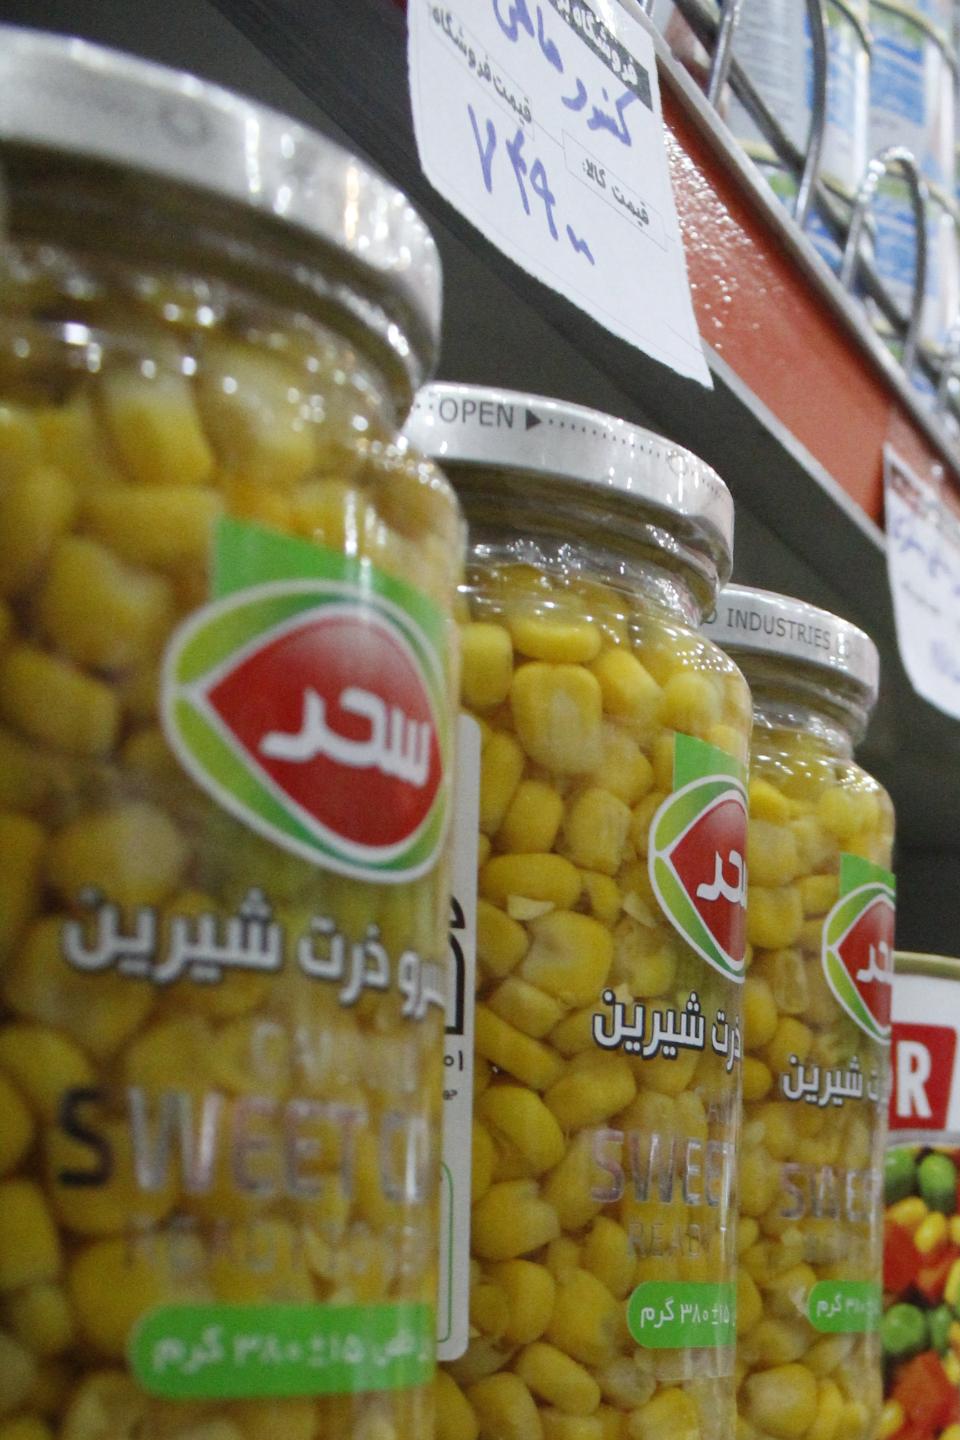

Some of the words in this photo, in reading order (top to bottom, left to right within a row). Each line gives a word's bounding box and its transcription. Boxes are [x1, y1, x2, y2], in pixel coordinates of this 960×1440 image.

[612, 186, 650, 227] قیمت
[438, 398, 515, 430] OPEN
[727, 607, 832, 651] INDUSTRIES
[259, 687, 431, 789] سحر
[696, 848, 748, 910] حر
[61, 885, 283, 984] شیرین
[299, 914, 391, 1007] ذرت
[592, 989, 706, 1061] شیرین
[782, 1054, 864, 1108] شیرین
[57, 1084, 370, 1200] SWEET
[640, 1296, 675, 1329] گرم
